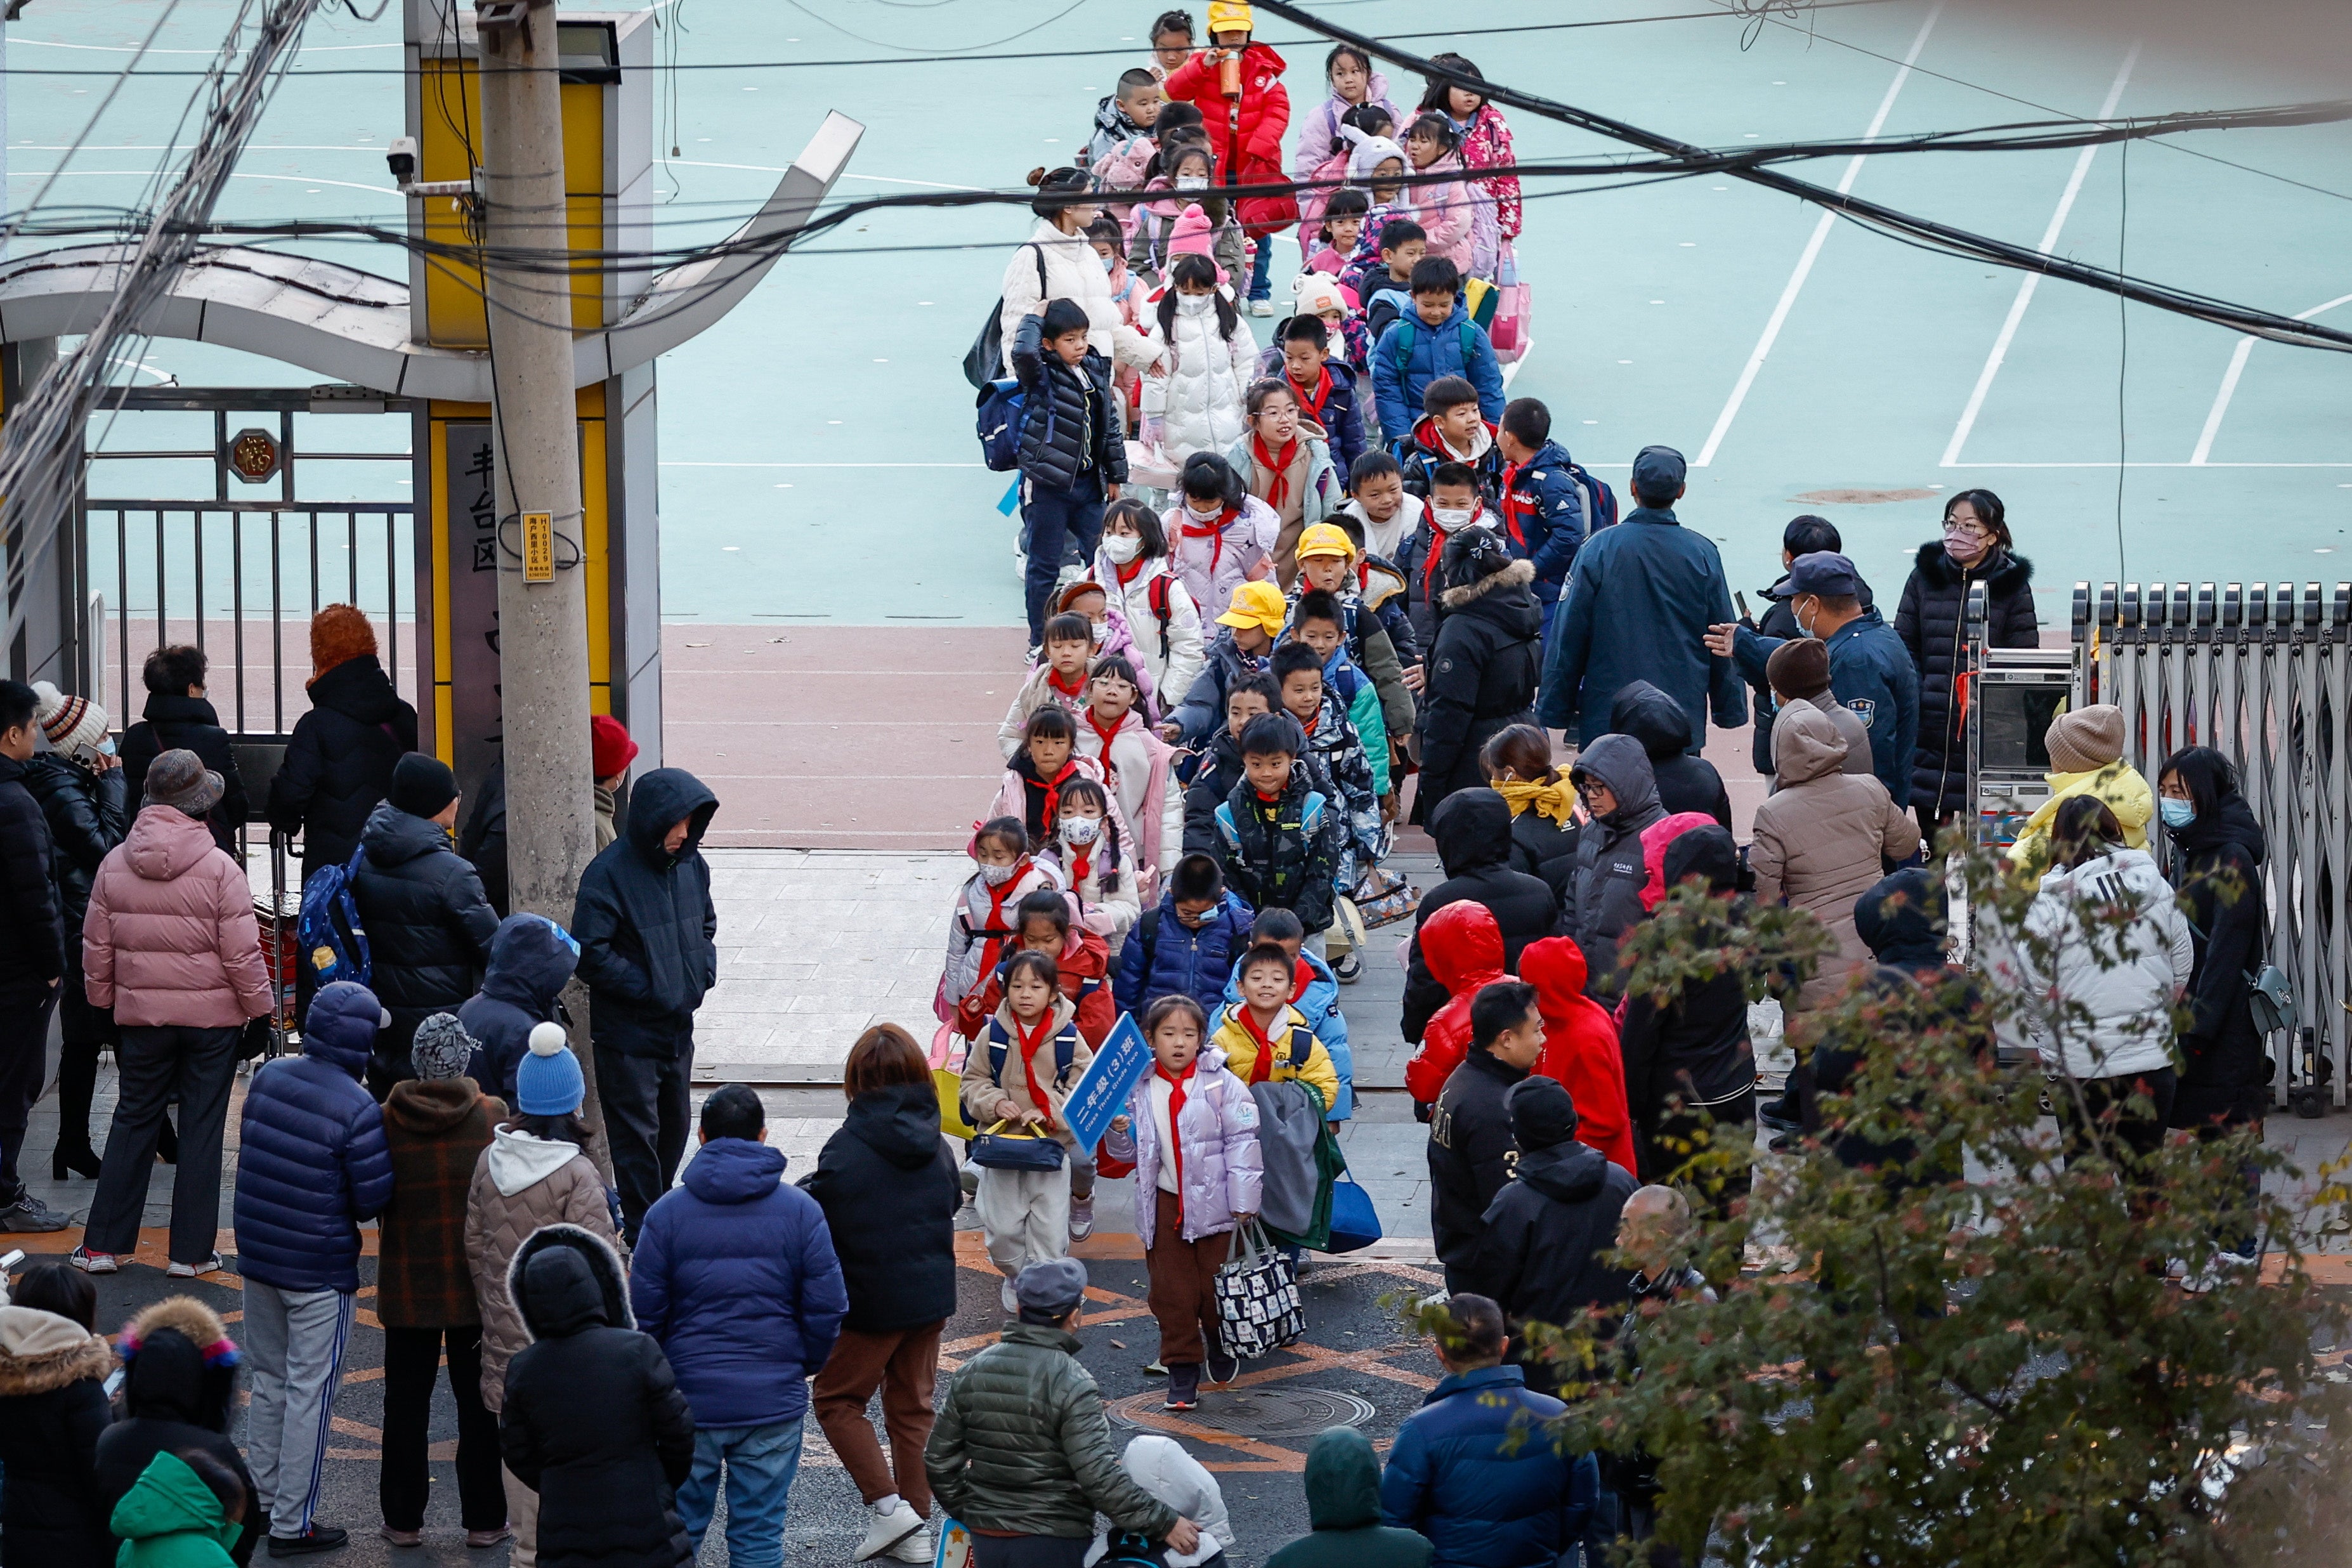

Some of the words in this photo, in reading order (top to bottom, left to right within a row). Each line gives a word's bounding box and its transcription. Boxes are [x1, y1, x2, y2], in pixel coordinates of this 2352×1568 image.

[530, 517, 539, 563] 海户西里小区
[467, 1036, 483, 1051] 022
[1077, 1034, 1135, 1125] 二年级(3)班
[1085, 1113, 1099, 1132] Class
[1098, 1090, 1113, 1111] Three
[1112, 1068, 1128, 1090] Grade
[1127, 1050, 1139, 1067] Two
